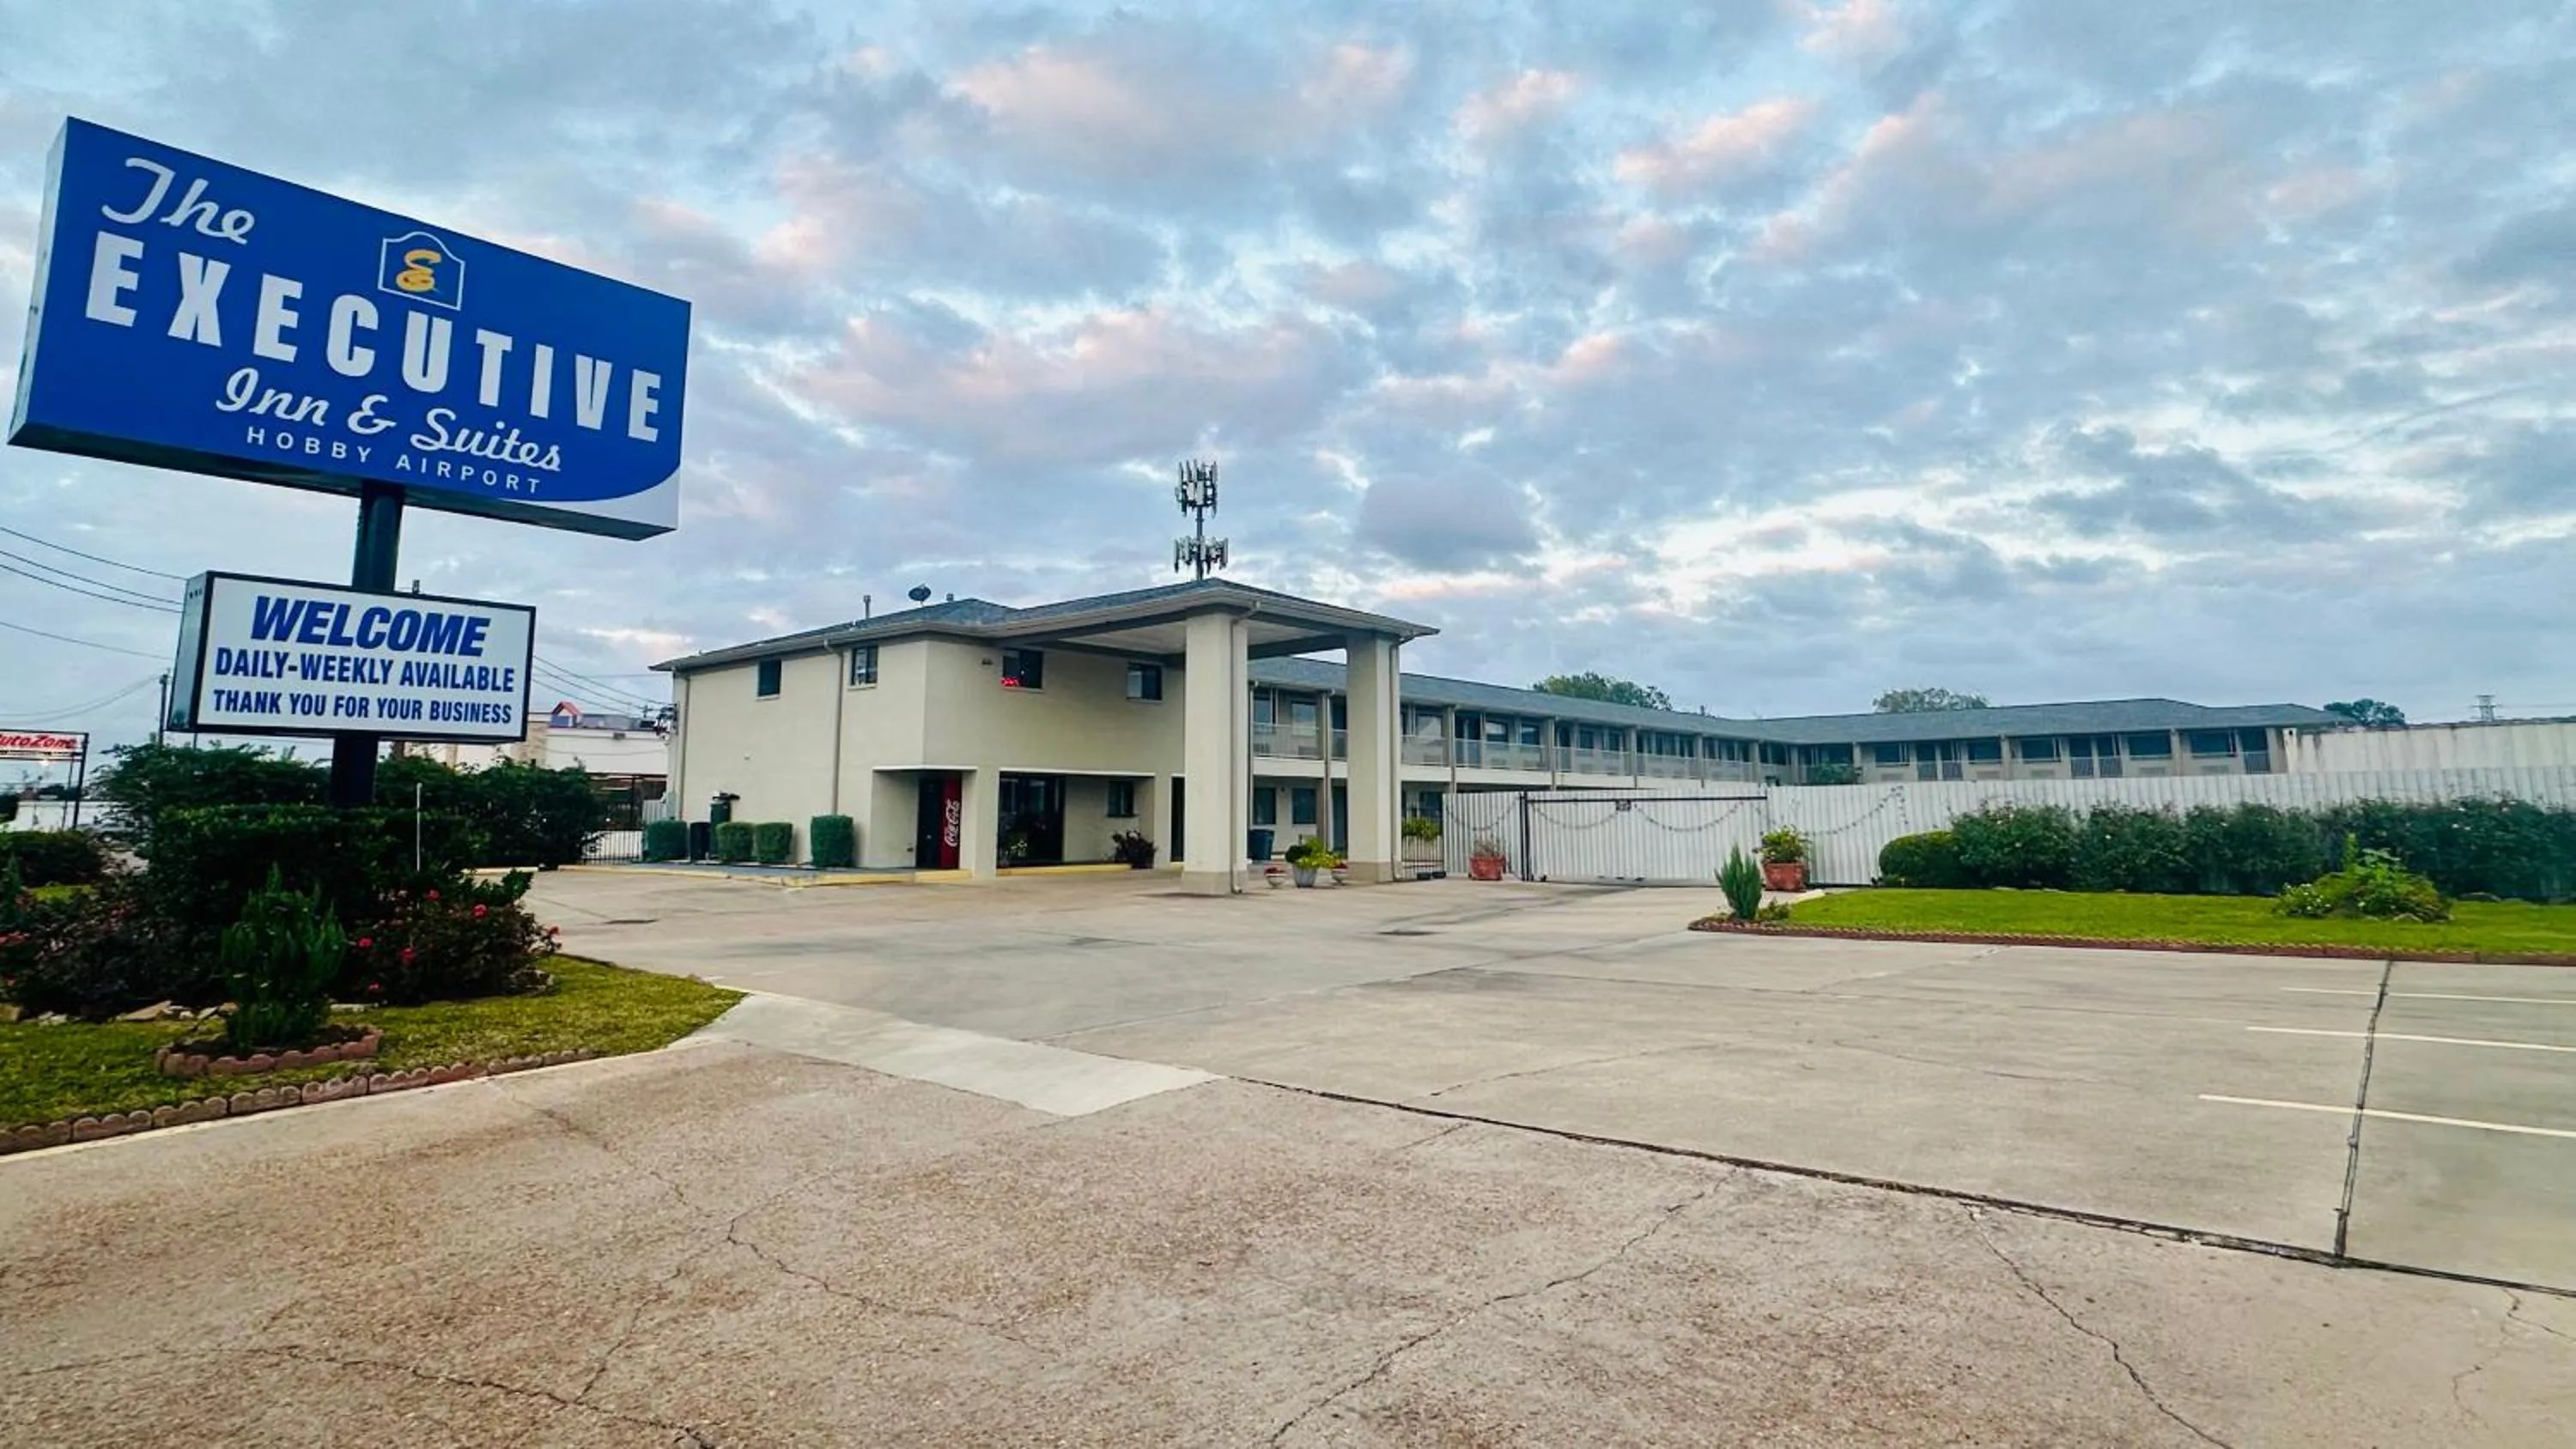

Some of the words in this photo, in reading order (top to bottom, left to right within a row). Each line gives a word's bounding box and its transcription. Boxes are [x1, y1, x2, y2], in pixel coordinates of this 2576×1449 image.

[101, 158, 254, 245] The
[85, 232, 661, 442] EXECUTIVE
[216, 367, 328, 426] Inn
[348, 396, 396, 433] &
[411, 409, 561, 471] Suites
[247, 427, 372, 464] HOBBY
[397, 456, 540, 494] AIRPORT
[252, 597, 489, 656] WELCOME
[216, 648, 393, 685] DAILY-WEEKLY
[400, 661, 514, 692] AVAILABLE
[213, 689, 282, 713] THANK
[289, 692, 325, 718] YOU
[334, 696, 368, 718] FOR
[375, 697, 422, 720] YOUR
[429, 700, 512, 724] BUSINESS
[0, 734, 76, 749] utoZone
